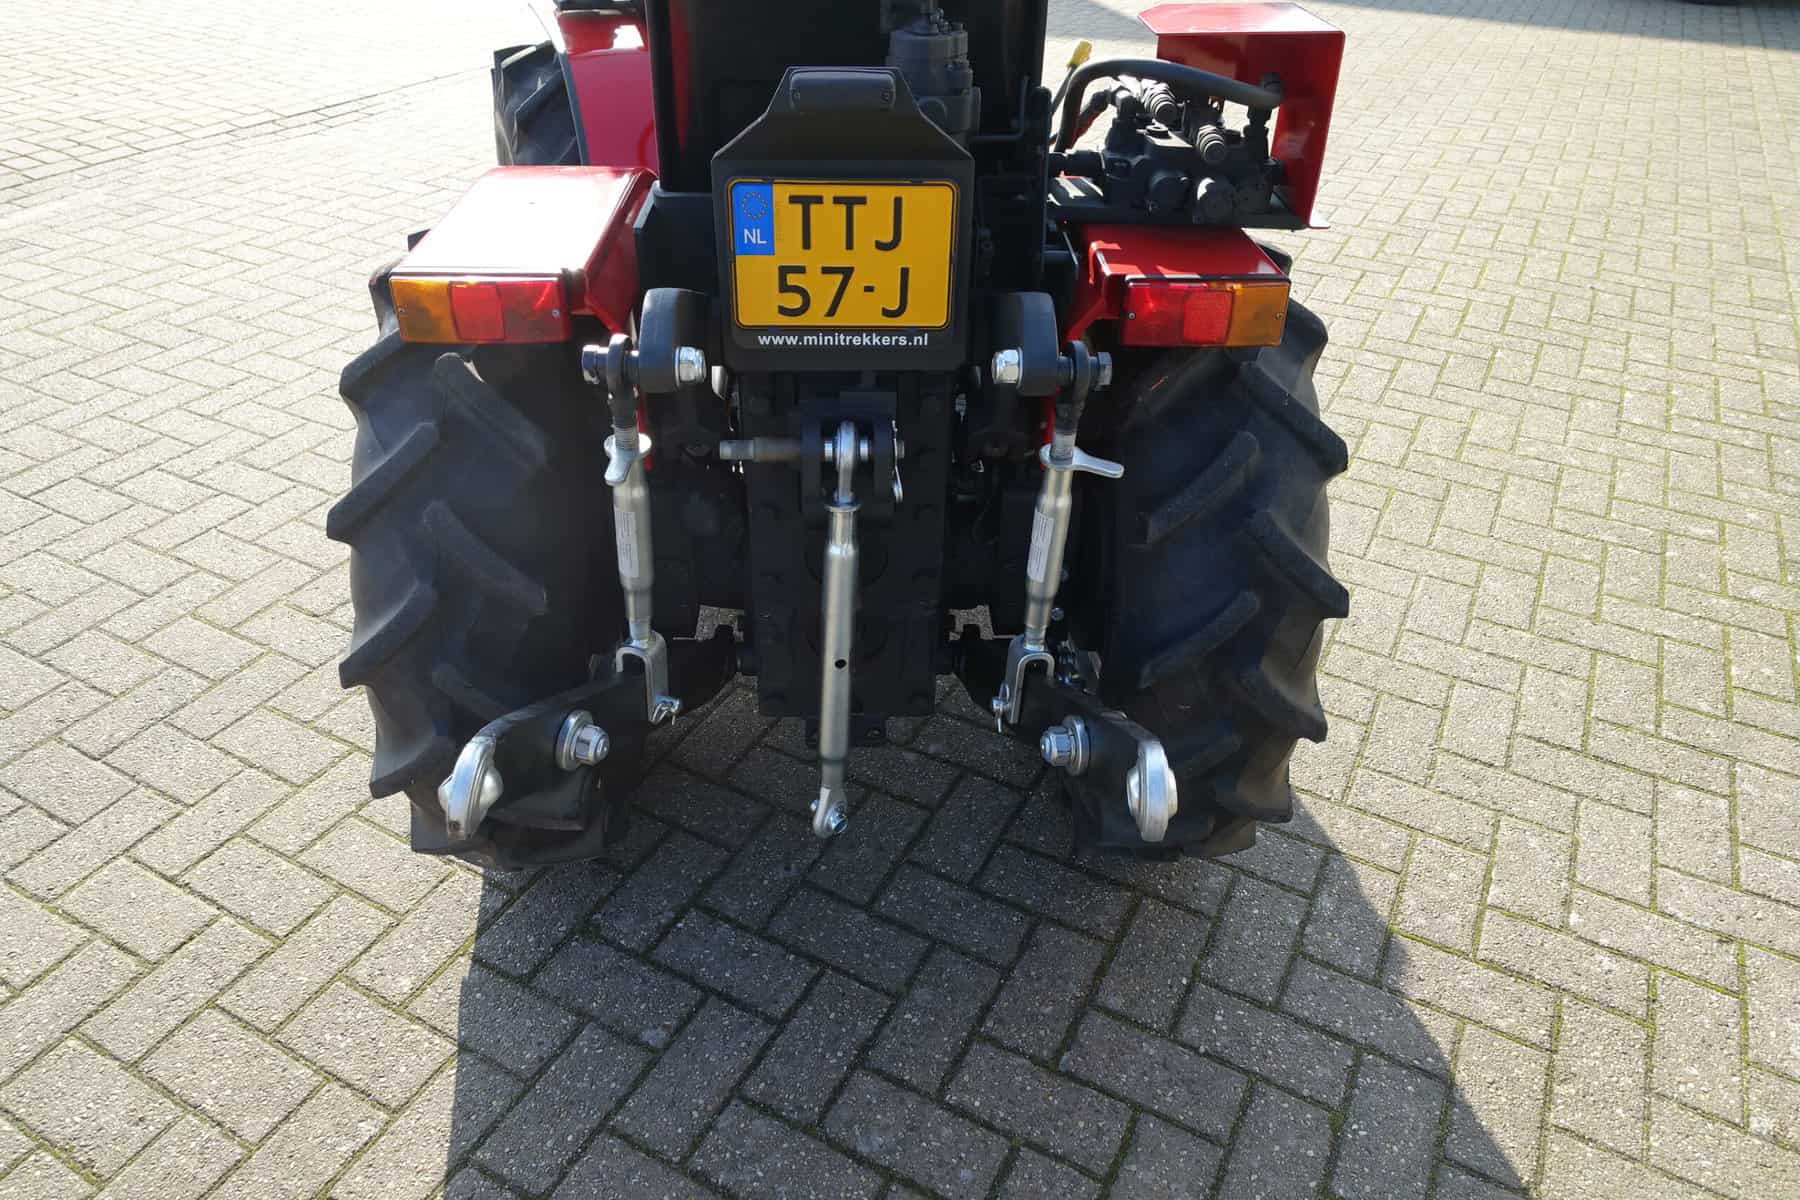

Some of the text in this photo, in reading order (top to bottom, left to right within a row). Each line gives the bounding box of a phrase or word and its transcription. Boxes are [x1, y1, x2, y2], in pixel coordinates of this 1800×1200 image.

[744, 229, 767, 244] NL
[788, 195, 903, 251] TTJ
[777, 265, 910, 318] 57-J
[758, 333, 929, 346] www.minitrekkers.nl
